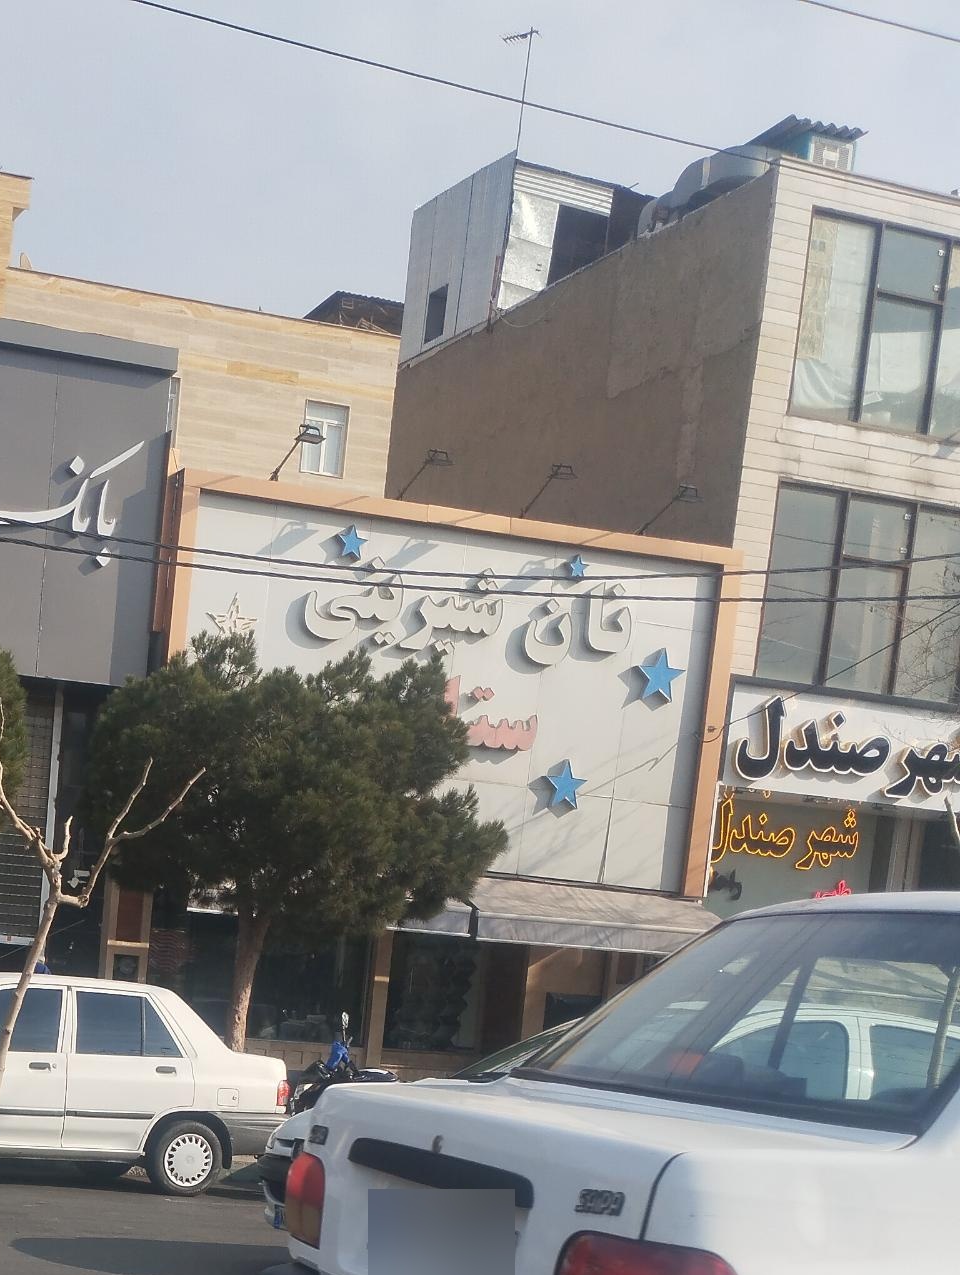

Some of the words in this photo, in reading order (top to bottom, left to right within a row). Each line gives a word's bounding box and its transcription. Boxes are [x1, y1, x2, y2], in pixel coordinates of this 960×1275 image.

[304, 555, 504, 656] شیرینی
[524, 581, 633, 666] نان
[443, 674, 539, 751] ستا
[735, 694, 891, 781] صندل
[711, 796, 796, 864] صندل
[795, 809, 859, 871] شهر
